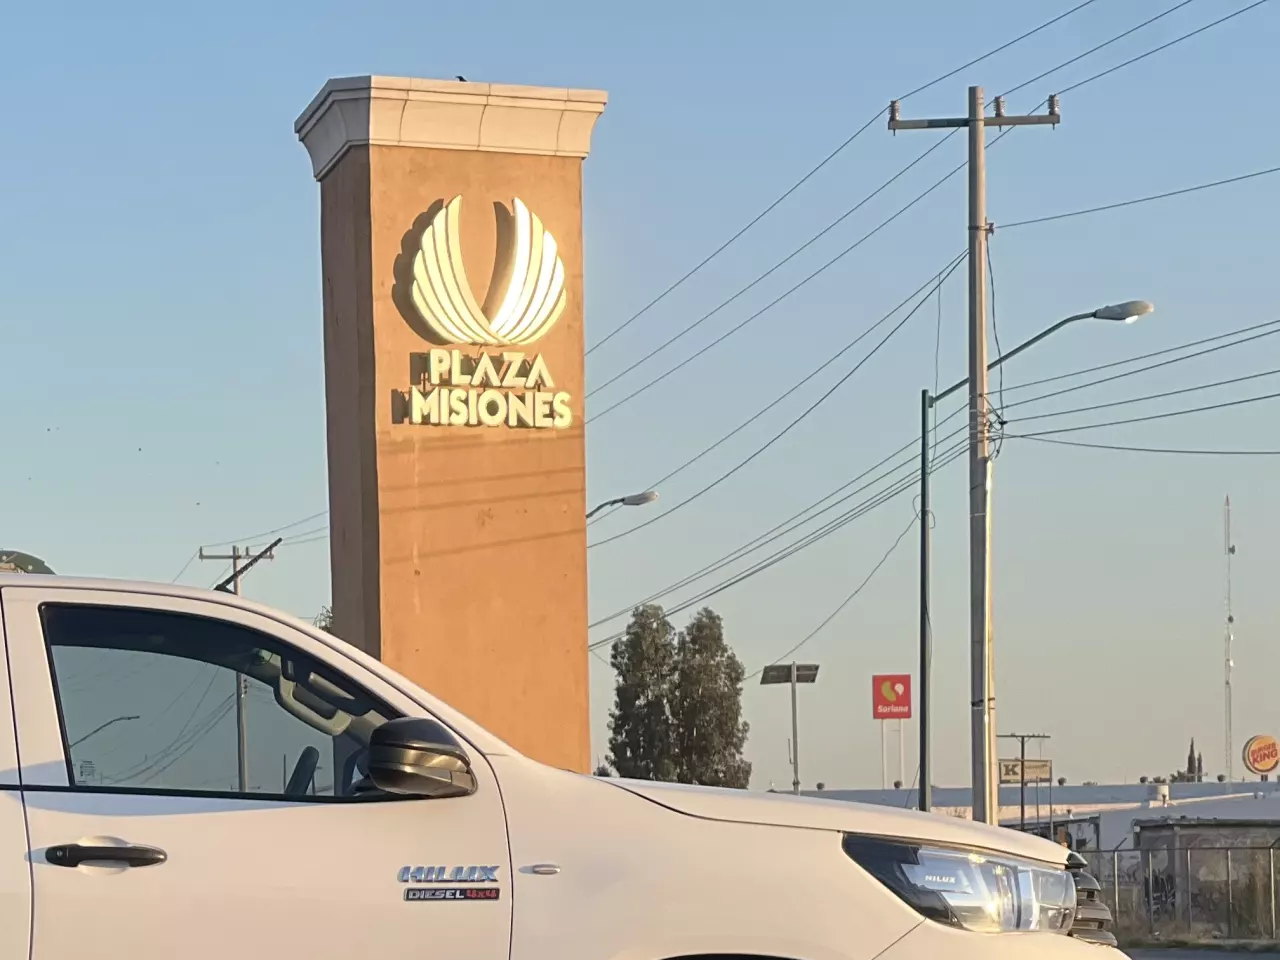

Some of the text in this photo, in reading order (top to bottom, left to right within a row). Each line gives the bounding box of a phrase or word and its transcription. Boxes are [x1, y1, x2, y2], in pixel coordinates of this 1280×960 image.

[430, 348, 555, 389] PLAZA
[411, 385, 573, 429] MISIONES
[877, 704, 909, 714] Soriana
[1252, 748, 1278, 766] KING
[397, 865, 501, 882] HILUX
[925, 874, 956, 883] HILUX
[408, 890, 465, 899] DIESEL
